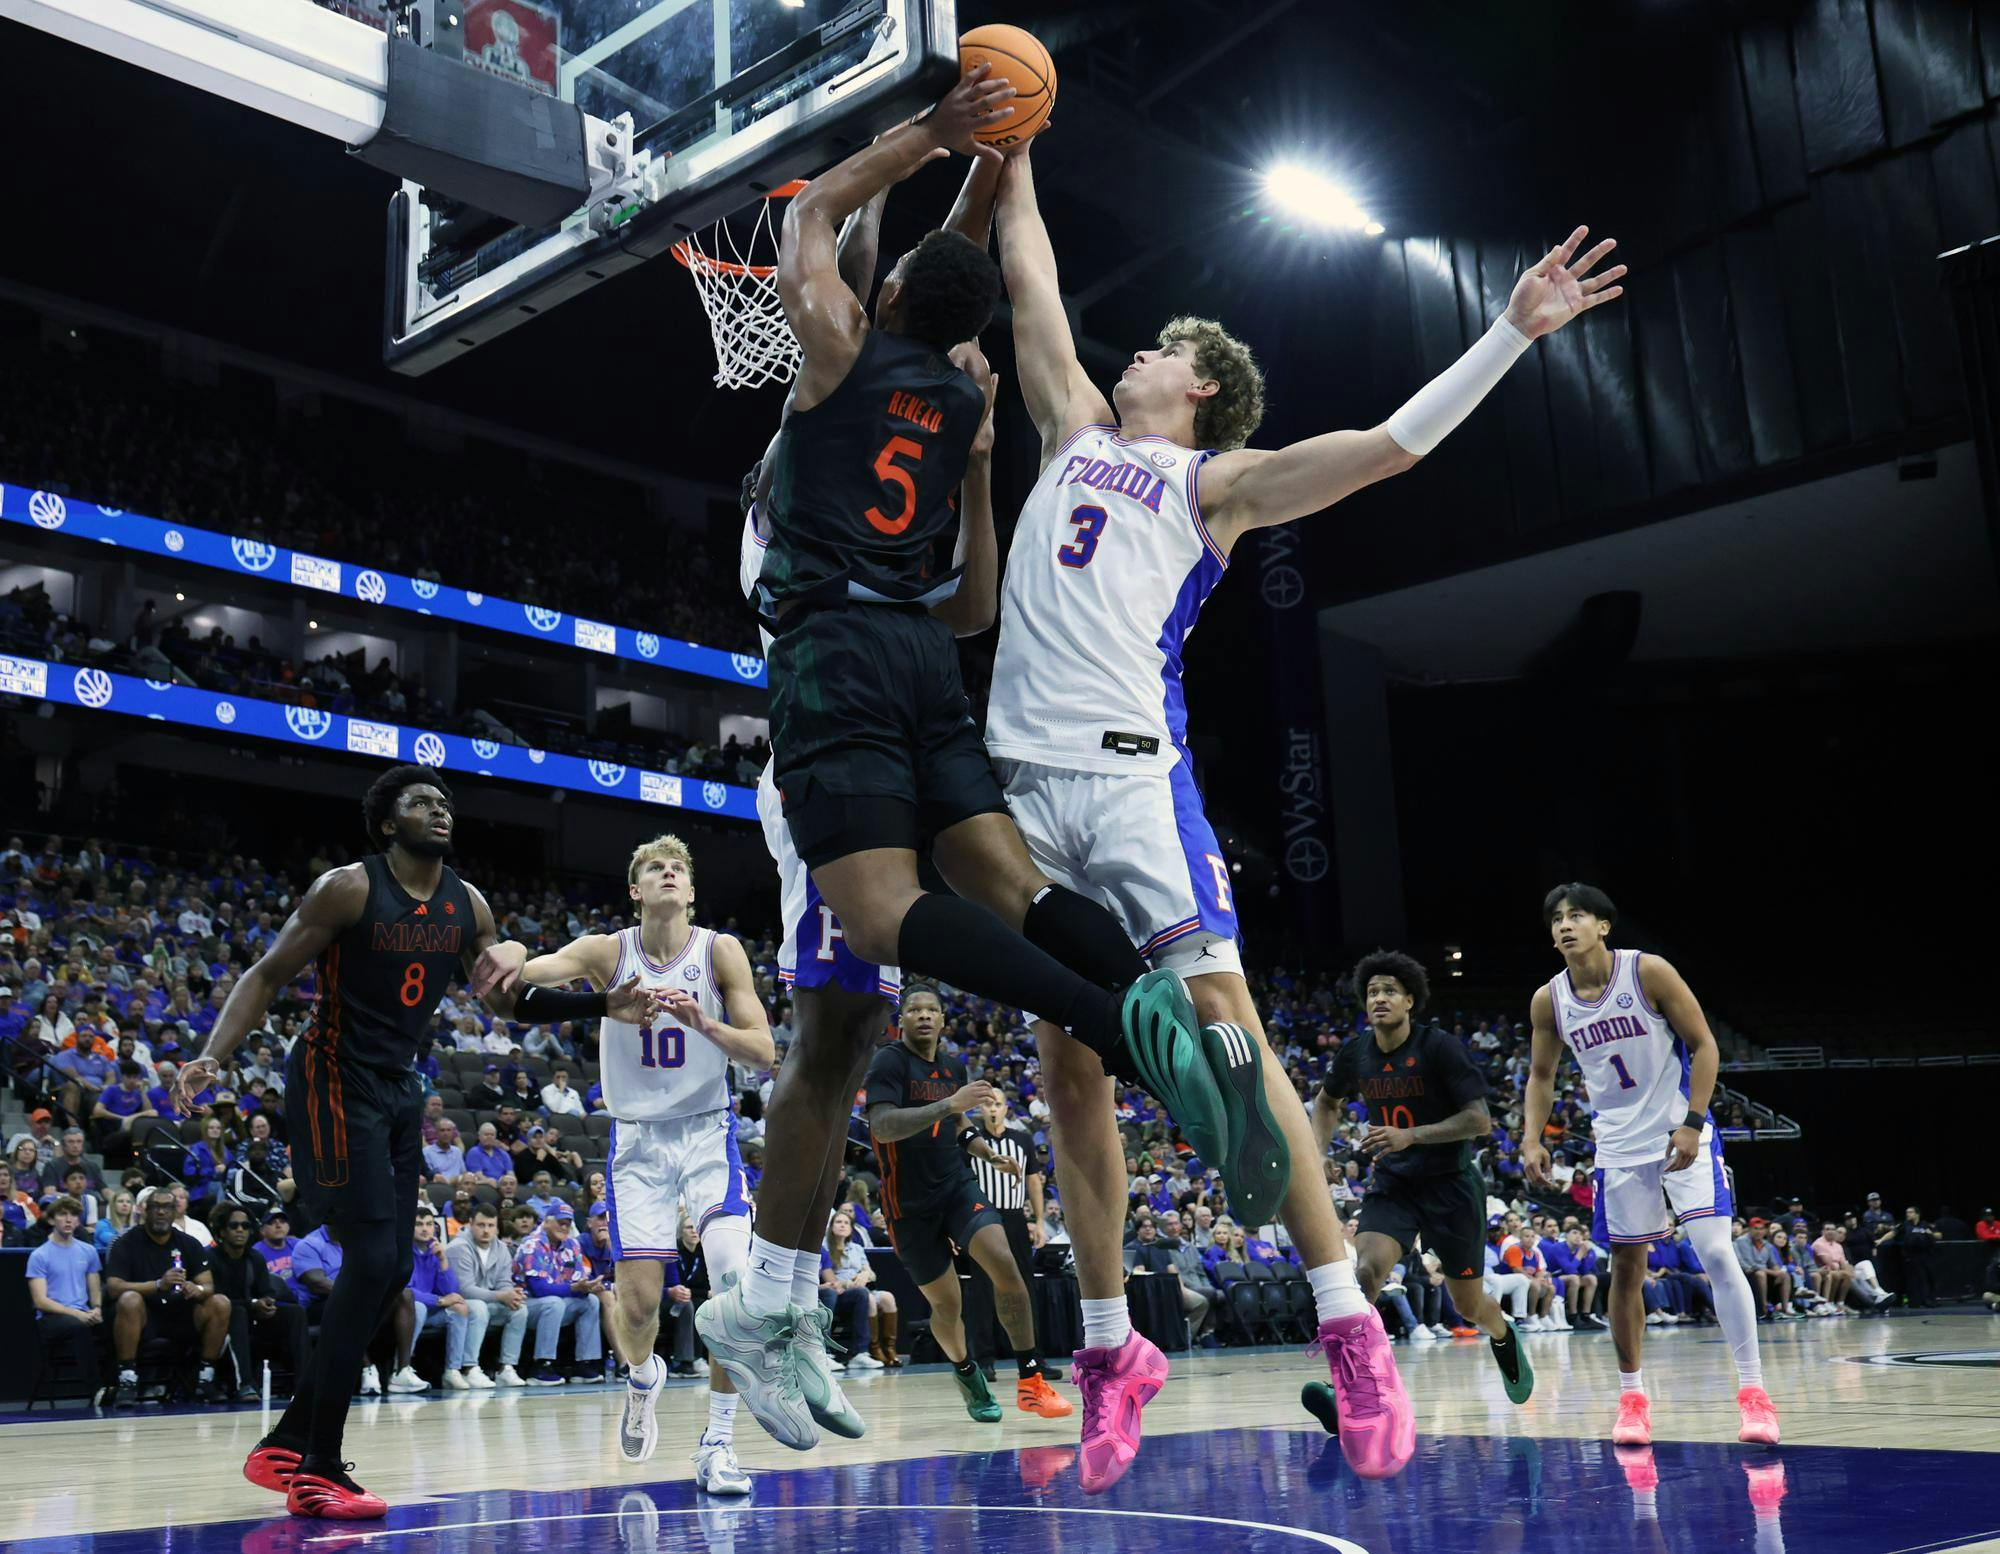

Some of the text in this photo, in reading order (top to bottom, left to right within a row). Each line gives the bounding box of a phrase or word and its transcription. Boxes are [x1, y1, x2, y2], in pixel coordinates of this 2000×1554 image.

[888, 391, 943, 433] RENEAU
[864, 435, 924, 535] 5
[1056, 455, 1167, 515] FLORIDA
[1057, 504, 1108, 569] 3
[1141, 740, 1151, 749] 50
[1279, 727, 1324, 840] VyStar
[1205, 852, 1232, 913] F
[372, 922, 461, 953] MIAMI
[401, 962, 425, 1007] 8
[639, 1027, 685, 1069] 10
[1569, 1015, 1648, 1053] FLORIDA
[1360, 1076, 1424, 1100] MIAMI
[1609, 1053, 1637, 1091] 1
[1380, 1105, 1414, 1128] 10
